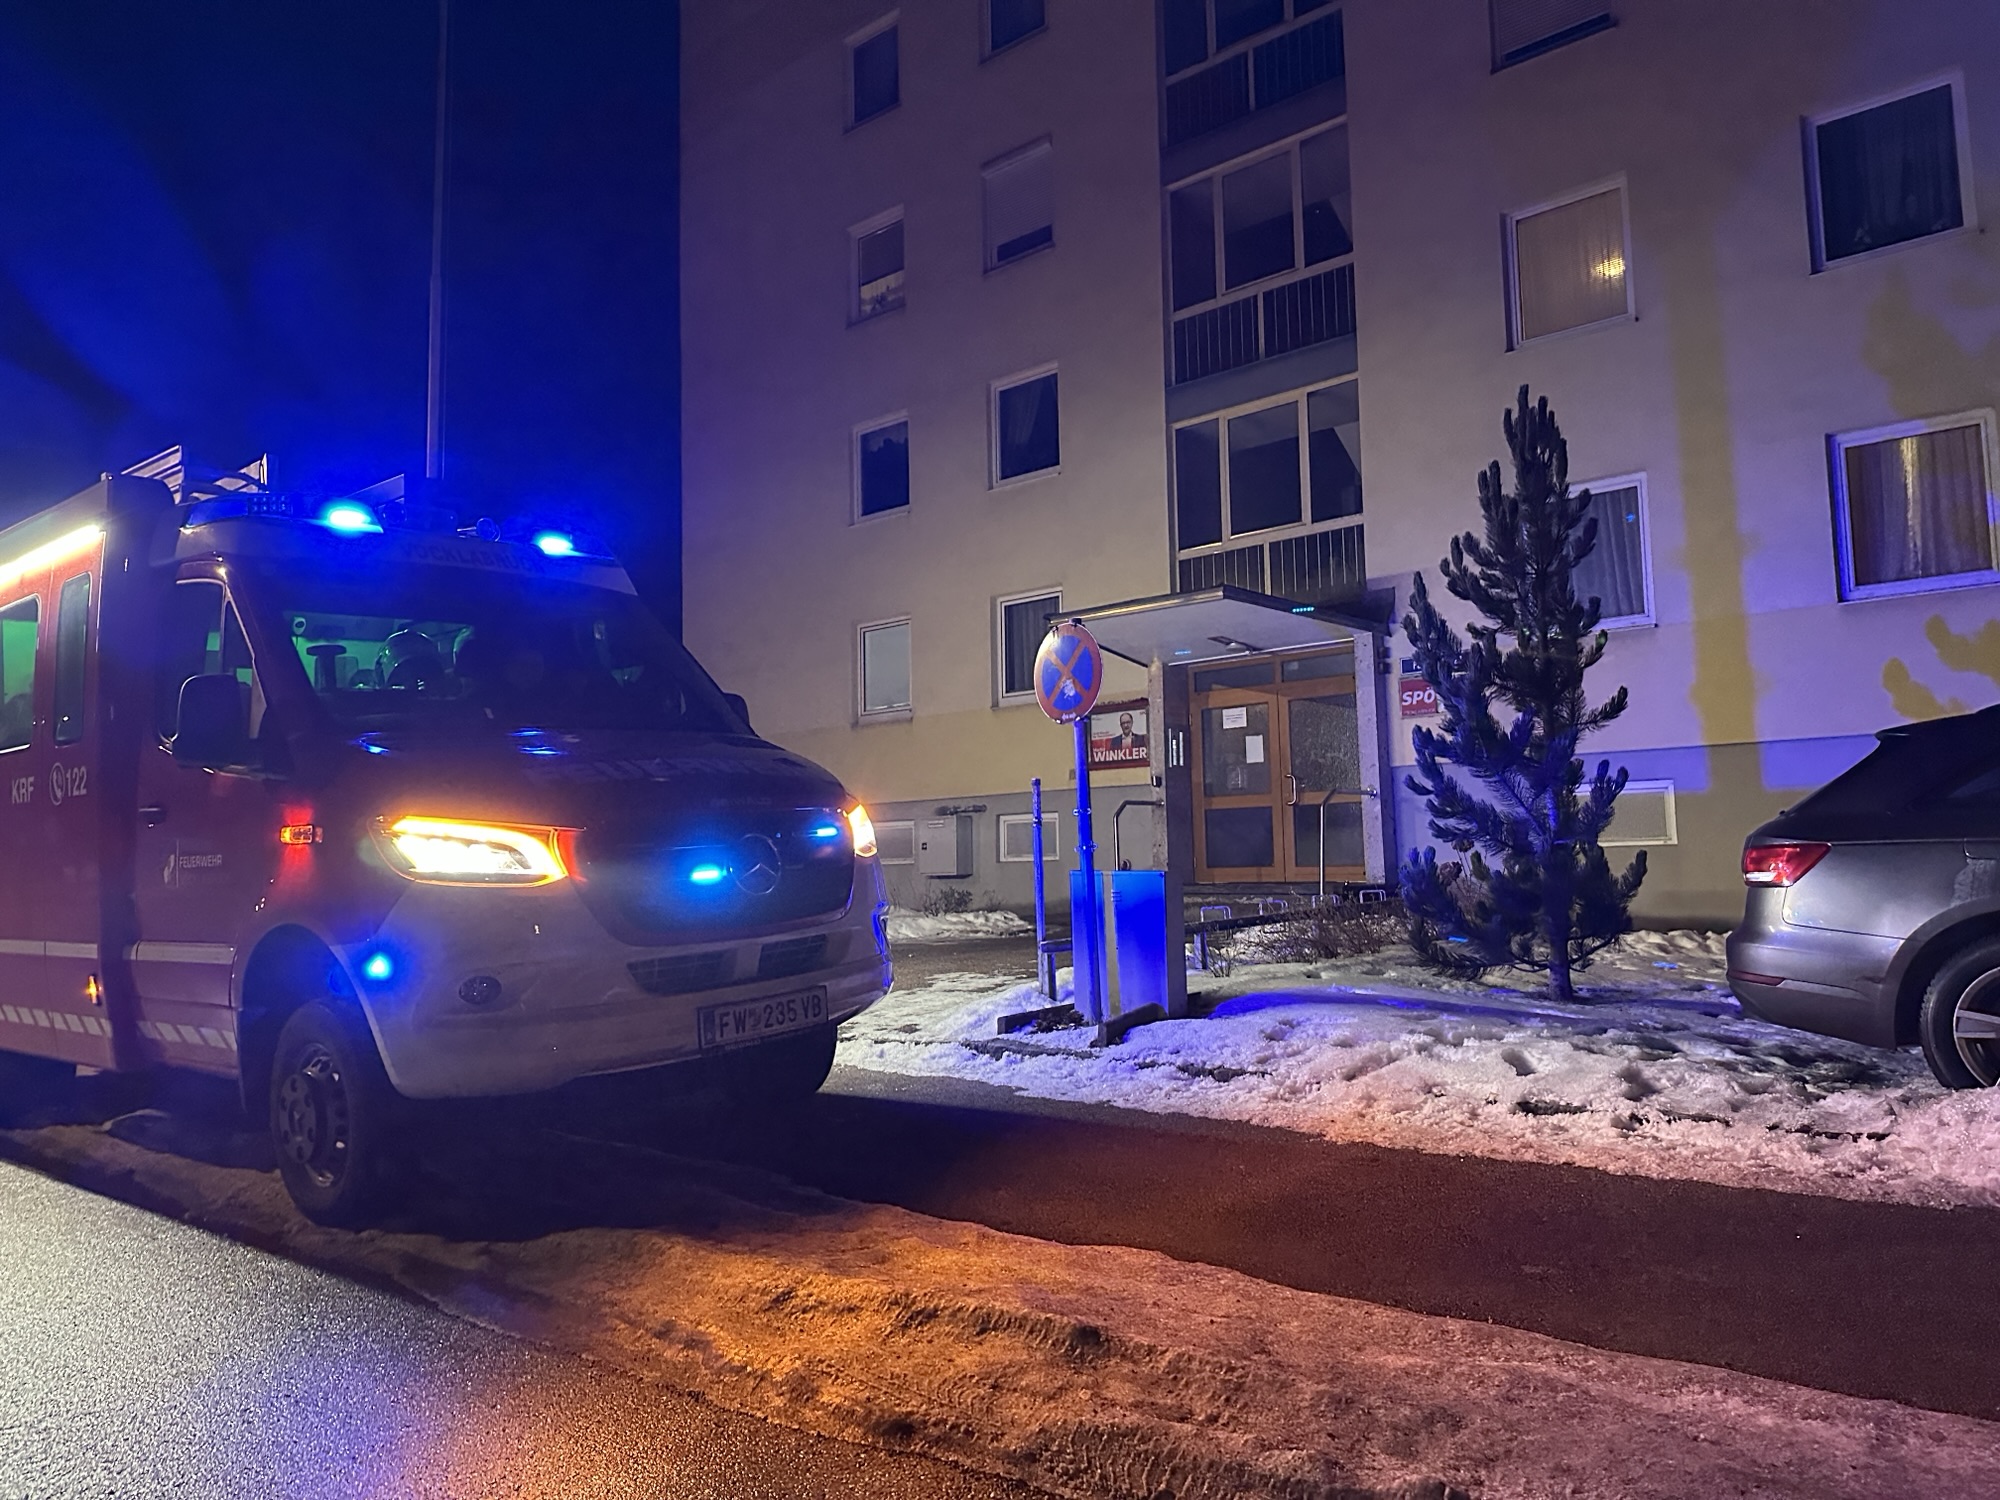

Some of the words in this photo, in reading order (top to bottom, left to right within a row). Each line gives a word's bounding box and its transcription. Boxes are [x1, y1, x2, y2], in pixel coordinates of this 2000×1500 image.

[1402, 686, 1436, 706] SPÖ
[1093, 747, 1147, 762] WINKLER
[11, 776, 35, 804] KRF
[66, 766, 88, 797] 122
[179, 854, 222, 868] FEUERWEHR
[719, 1008, 747, 1038] FW
[763, 999, 797, 1028] 235
[801, 994, 822, 1019] VB
